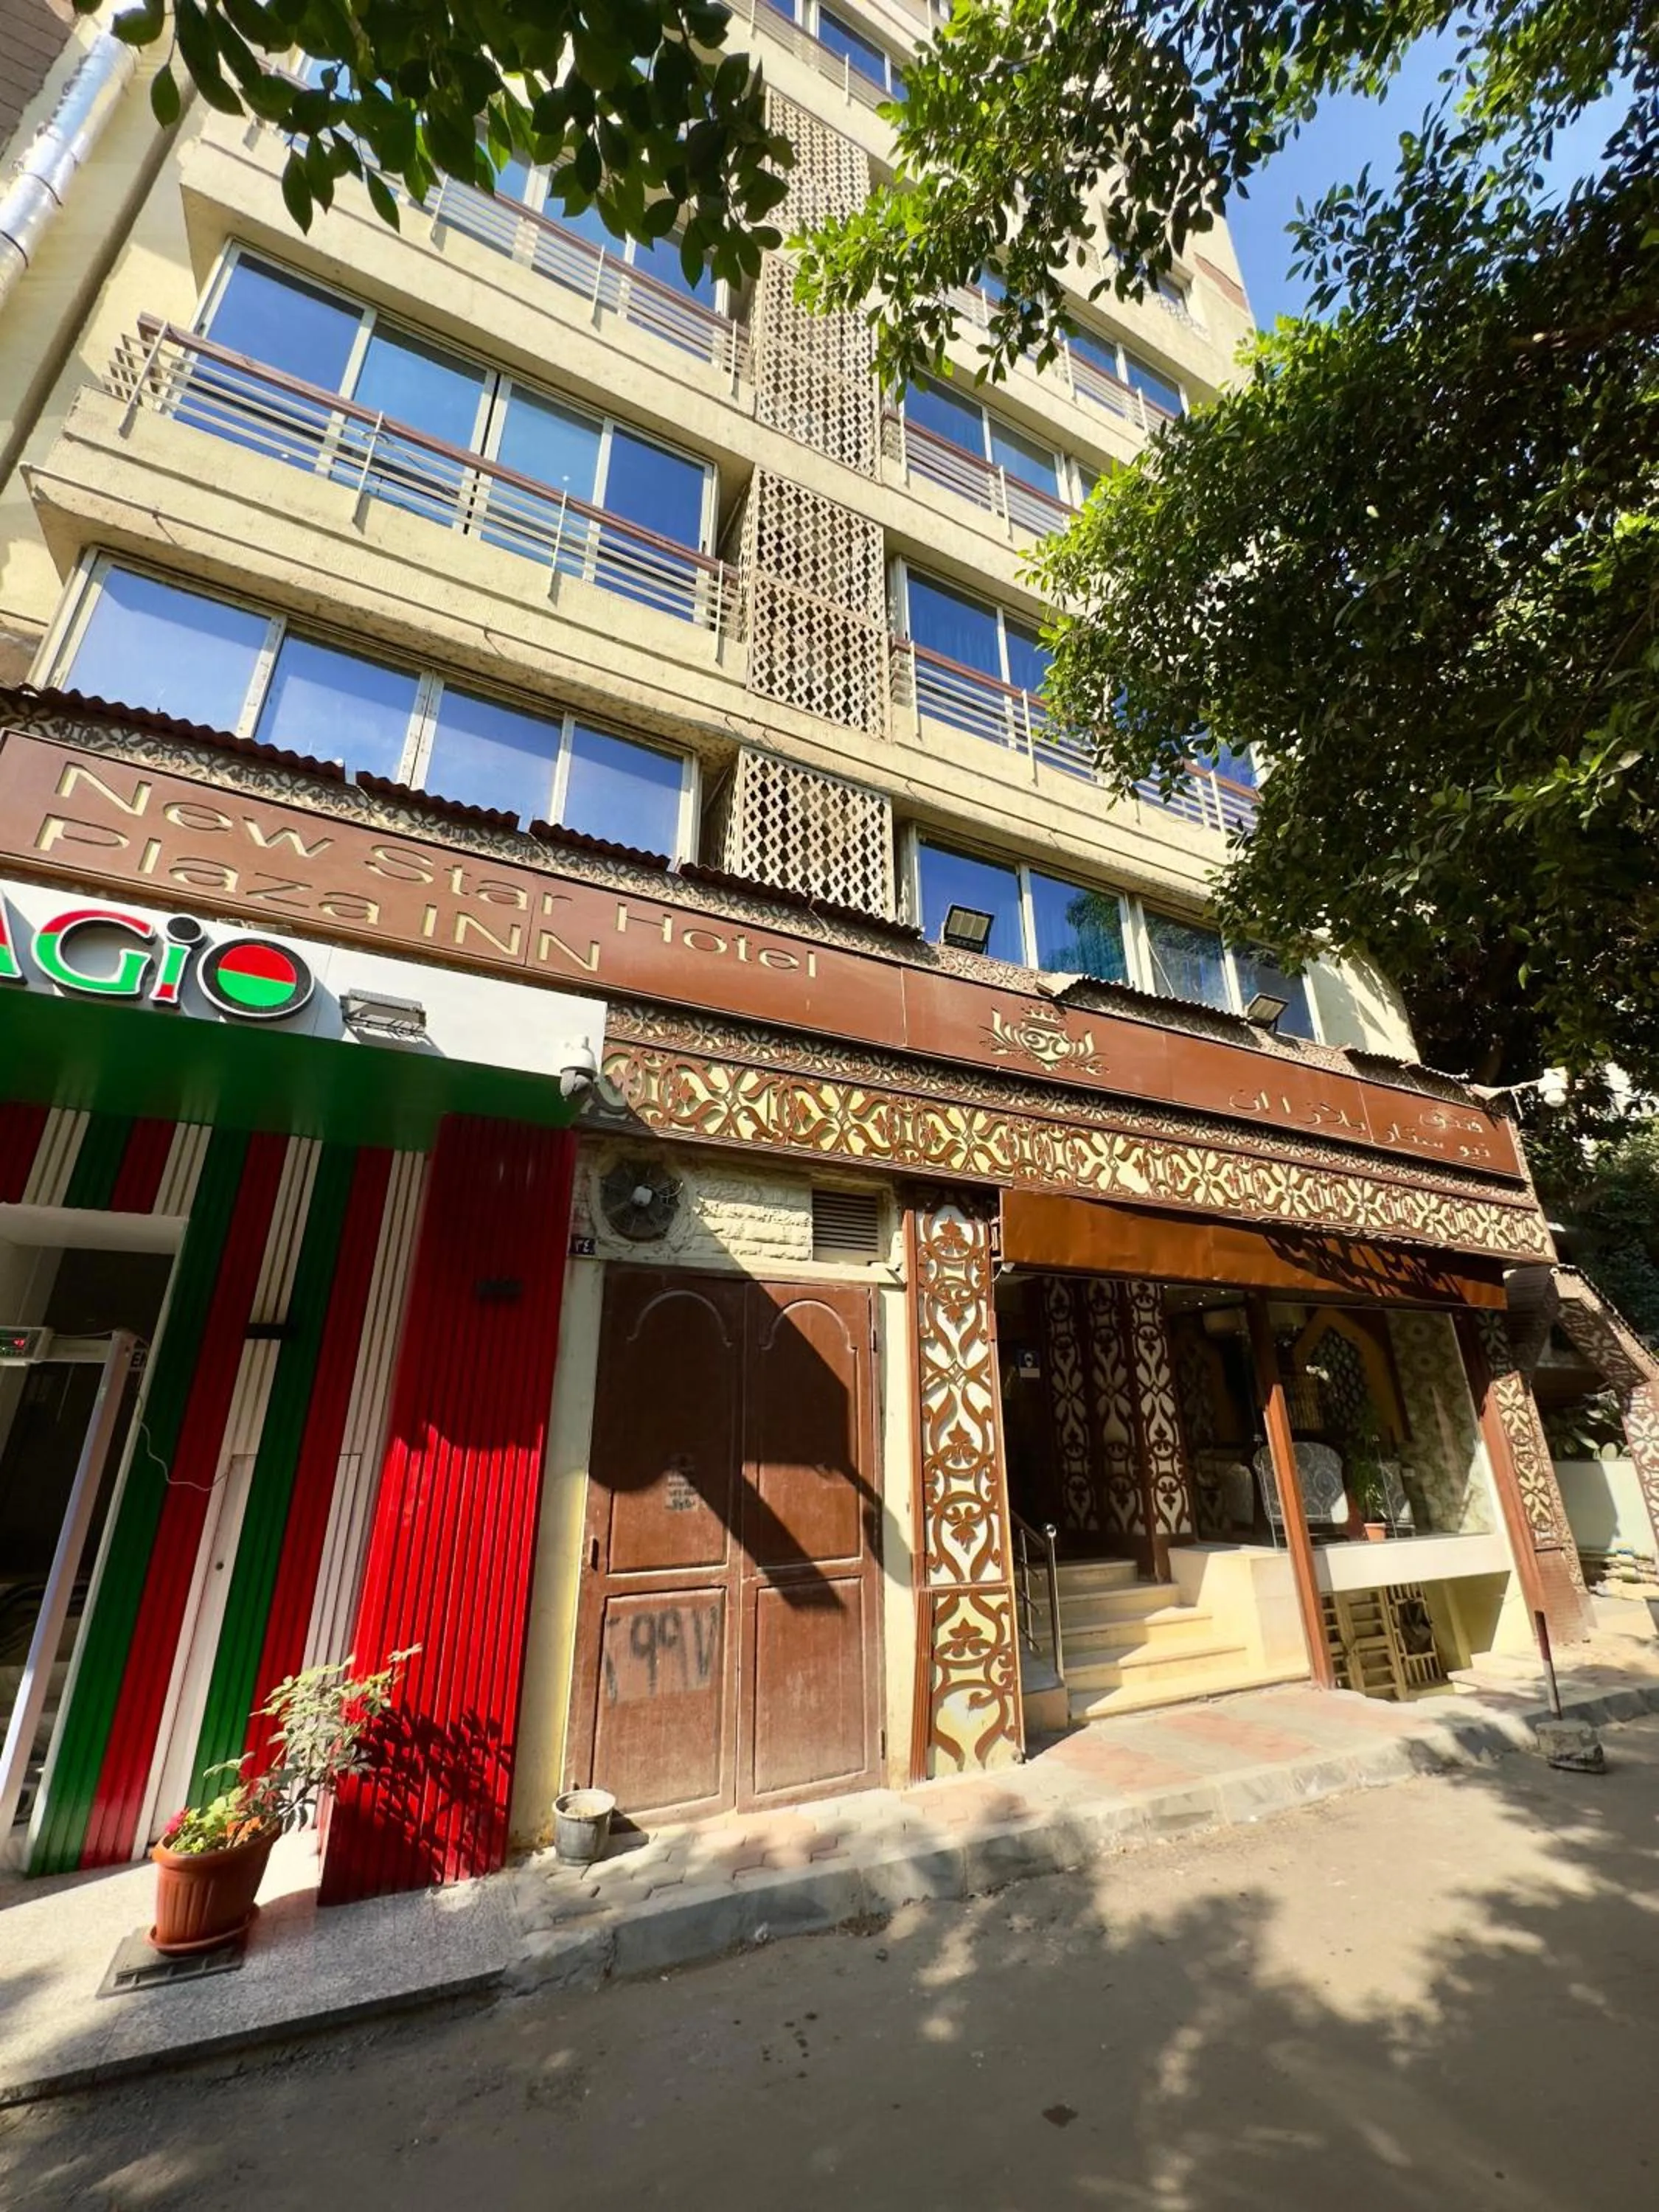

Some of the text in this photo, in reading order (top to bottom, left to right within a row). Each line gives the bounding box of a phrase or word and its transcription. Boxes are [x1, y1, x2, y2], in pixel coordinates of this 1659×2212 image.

[55, 762, 816, 978] New Star Hotel
[33, 814, 600, 973] Plaza INN
[1418, 1107, 1484, 1133] فندق
[1377, 1121, 1444, 1149] ستار
[1459, 1142, 1491, 1160] نيو
